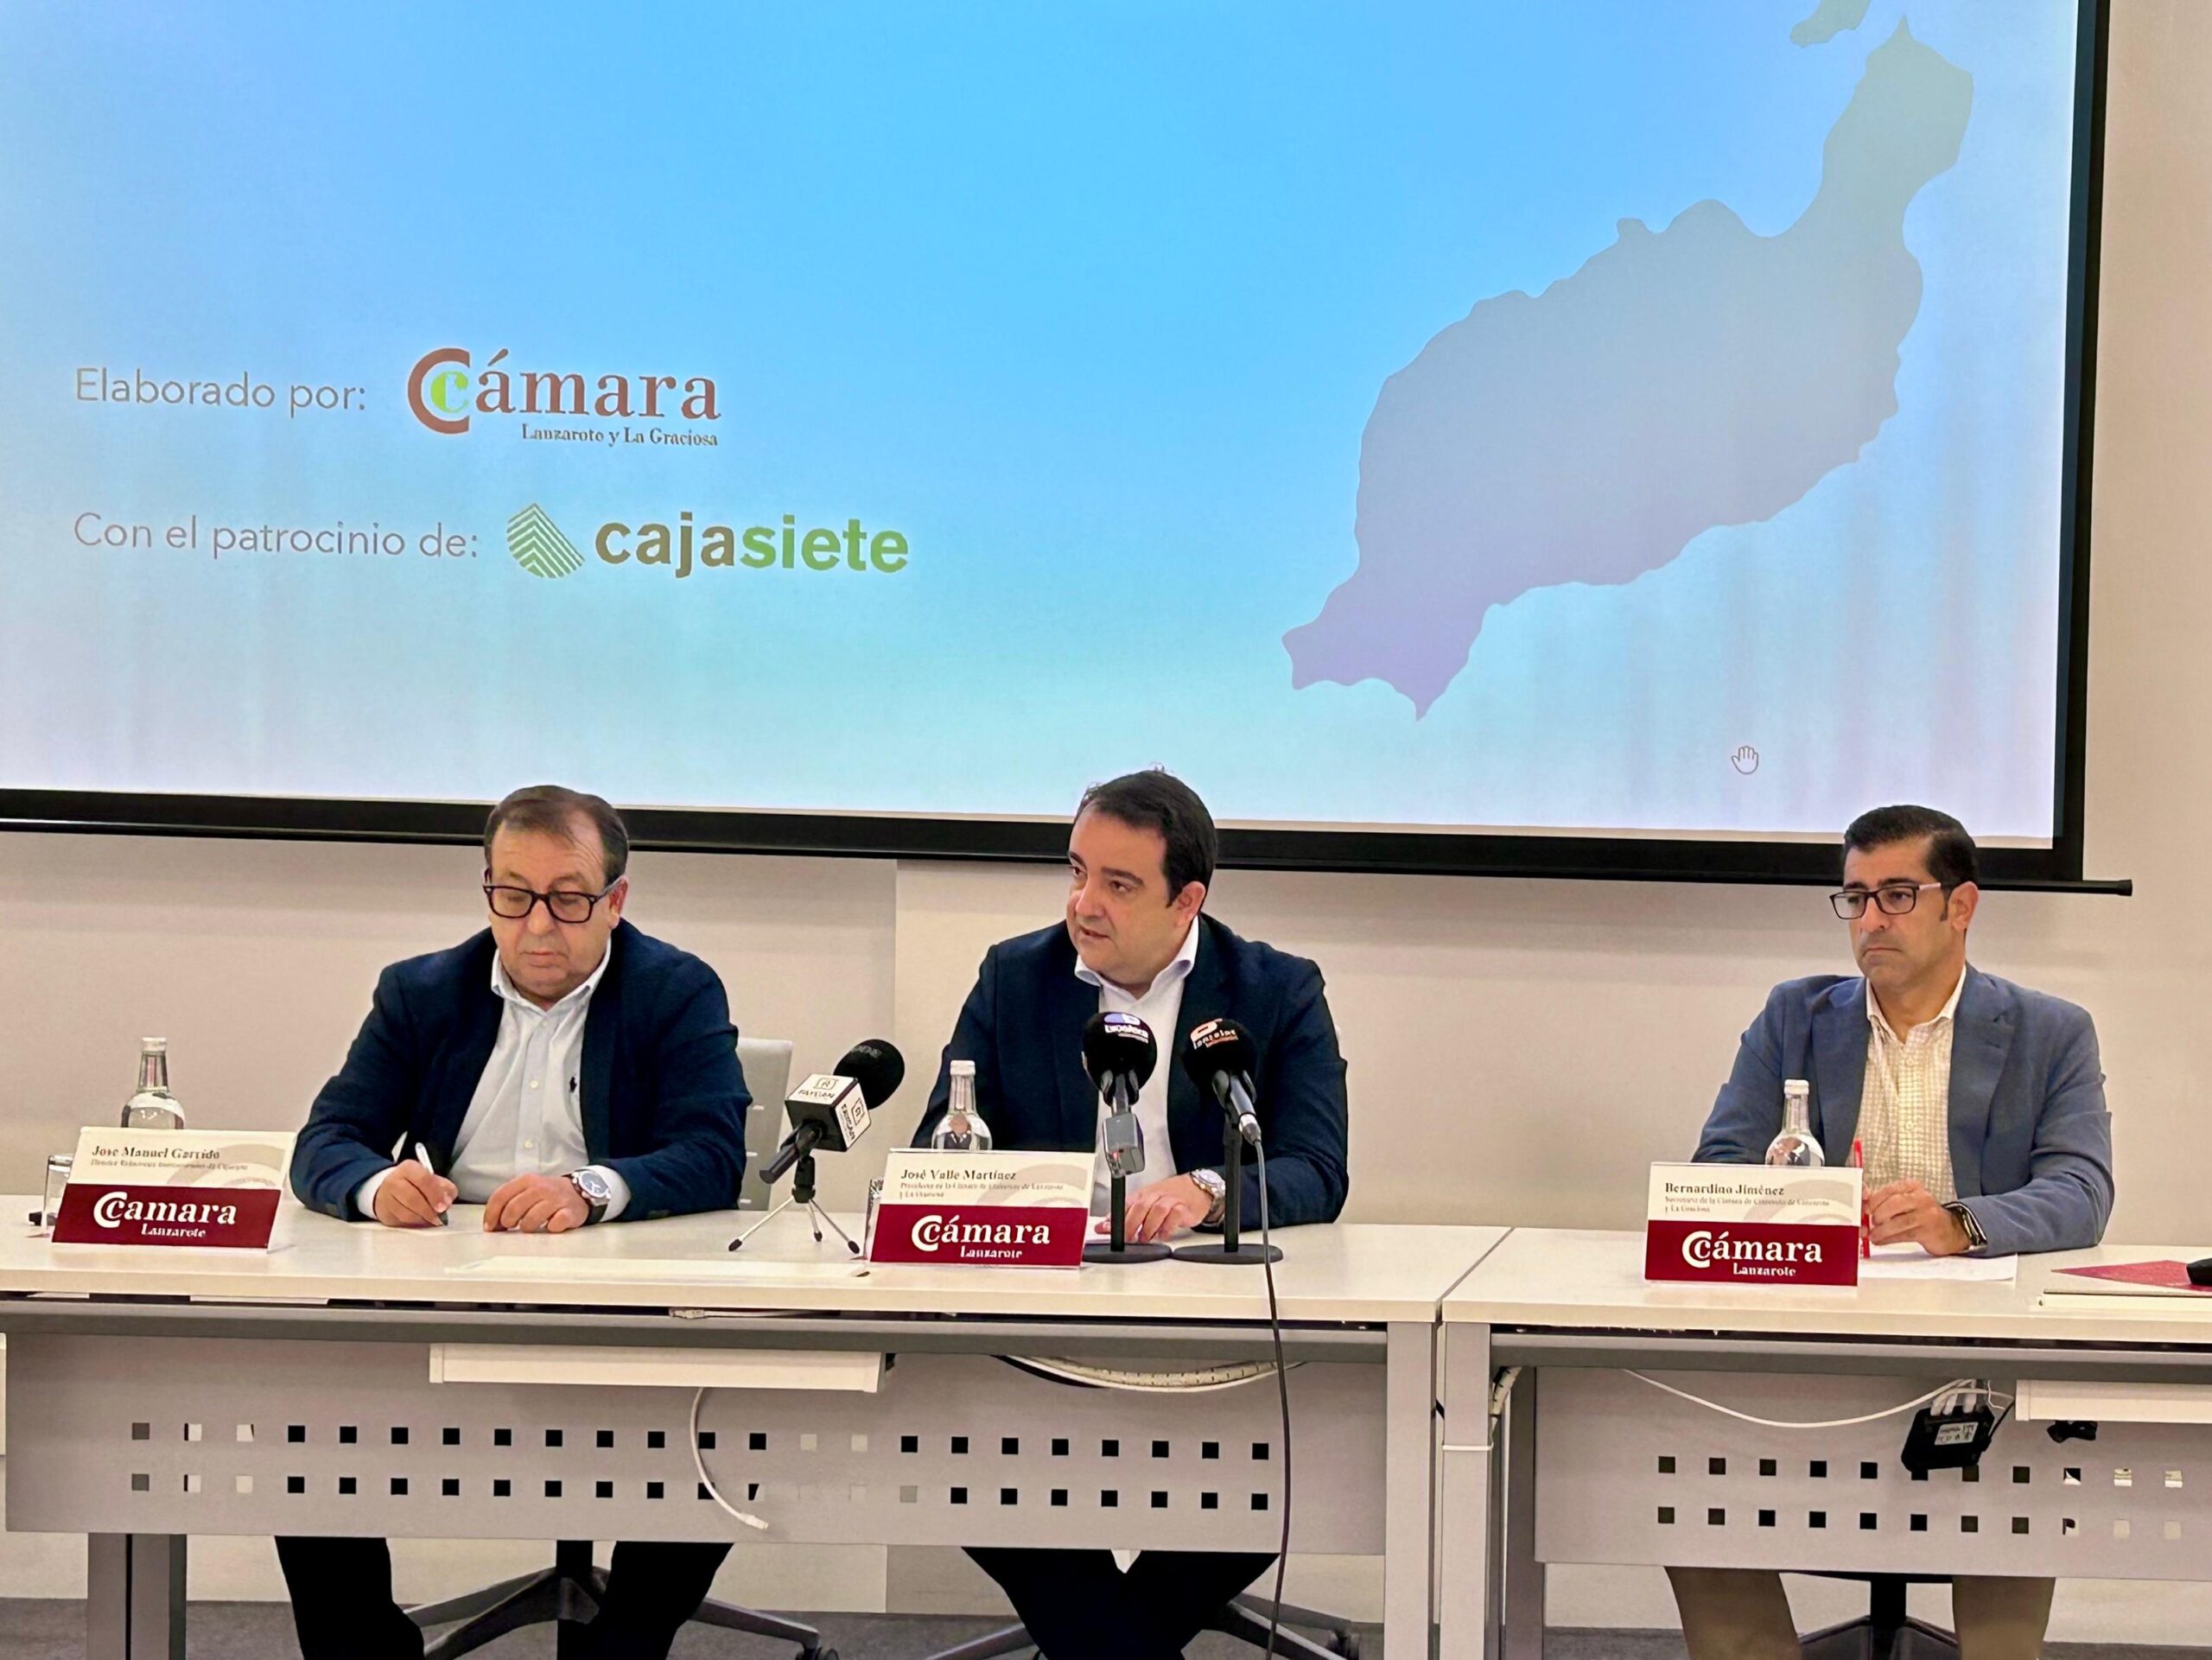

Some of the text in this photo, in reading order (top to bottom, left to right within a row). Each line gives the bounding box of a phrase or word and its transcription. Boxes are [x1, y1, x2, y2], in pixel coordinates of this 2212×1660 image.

[77, 367, 366, 419] Elaborado por:
[609, 431, 621, 447] y
[624, 427, 645, 443] La
[650, 427, 719, 447] Graciosa
[74, 512, 480, 560] Con el patrocinio de:
[595, 512, 909, 578] cajasiete
[122, 1147, 168, 1159] Manuel
[171, 1148, 221, 1160] Garrido
[900, 1169, 1017, 1181] José Valle Martínez
[1665, 1182, 1784, 1196] Bernardino Jiménez
[141, 1223, 207, 1238] Lanzarote
[1732, 1262, 1796, 1277] Lanzarote
